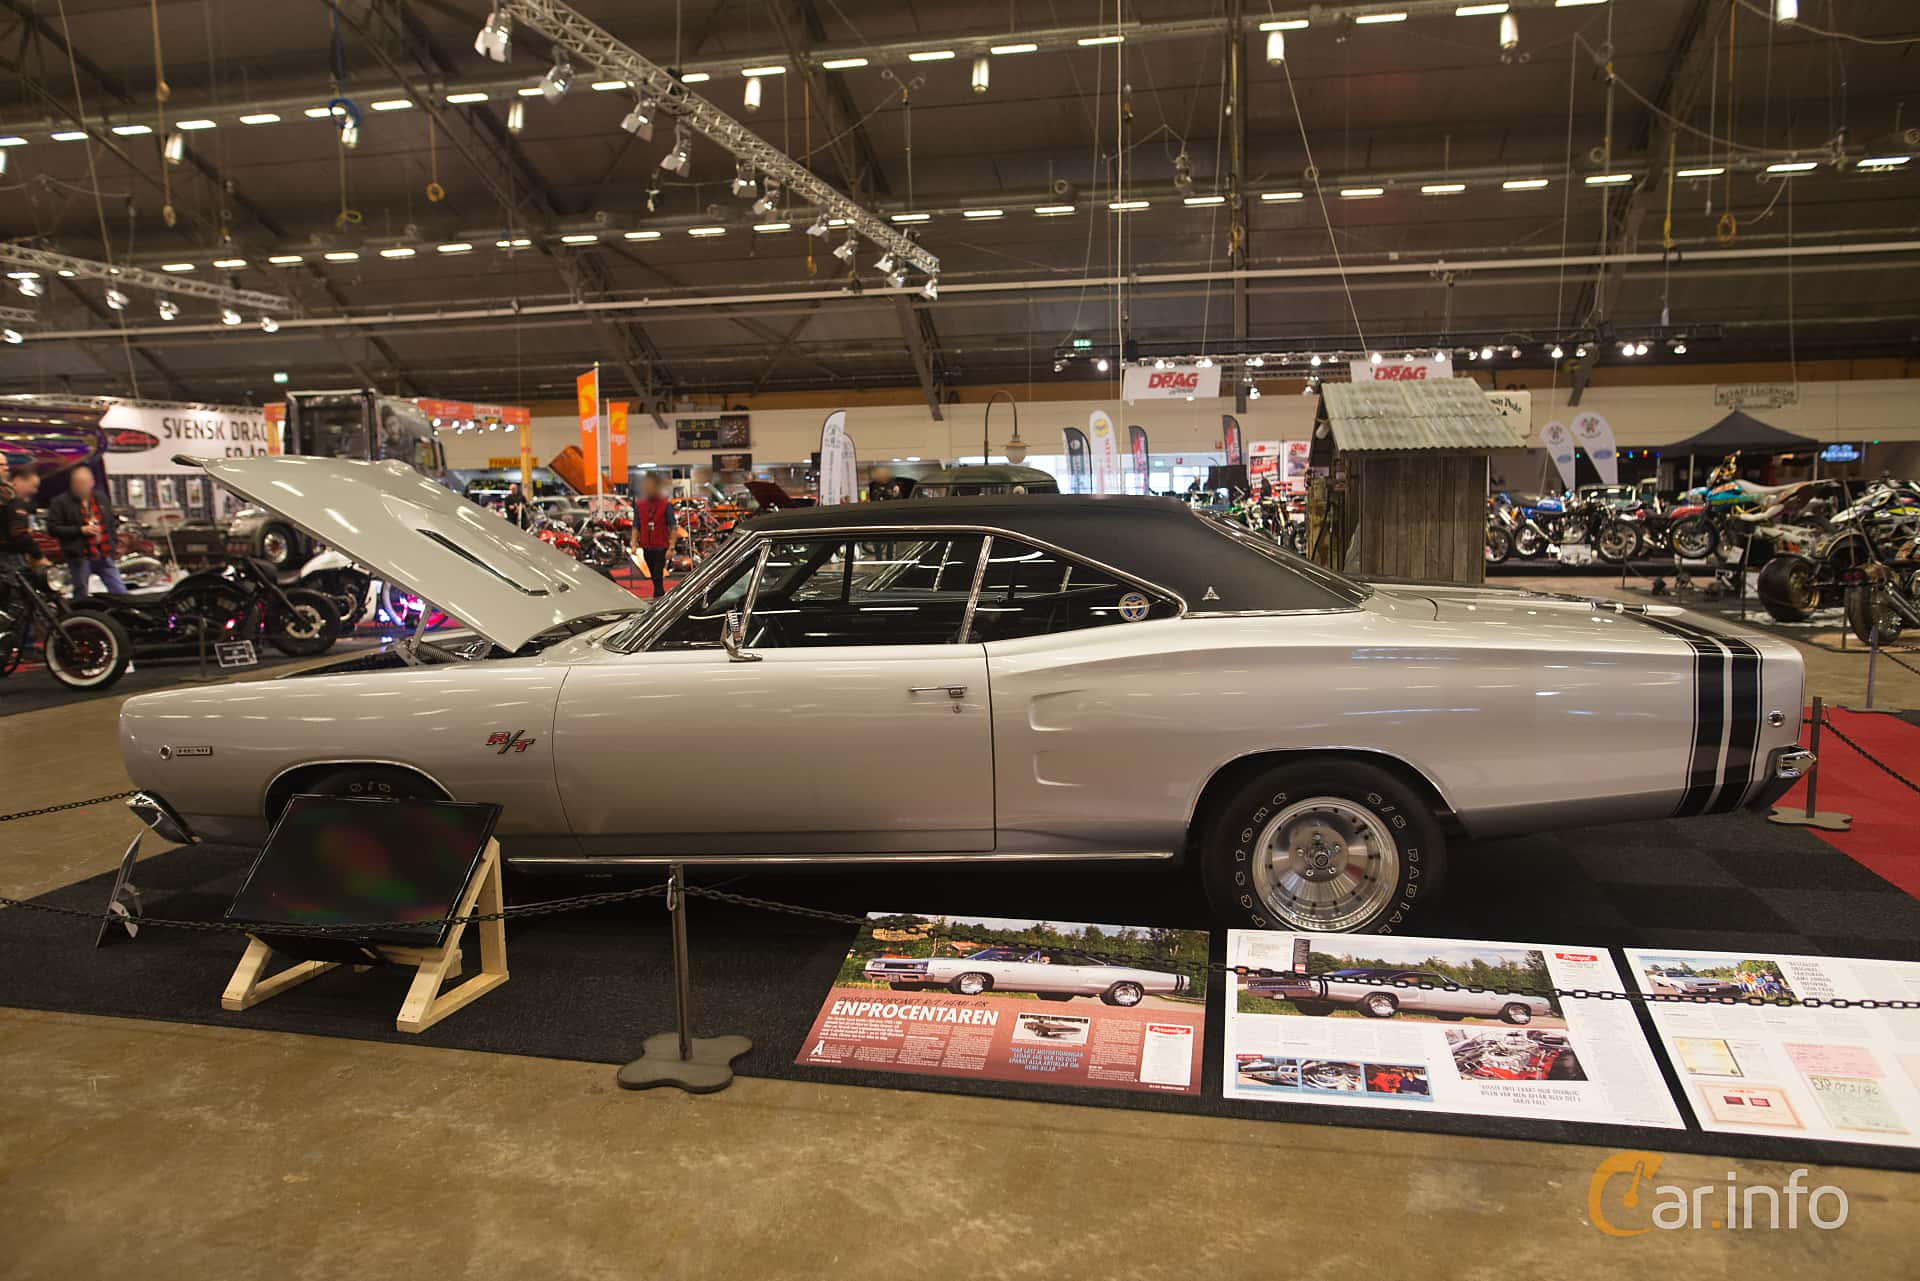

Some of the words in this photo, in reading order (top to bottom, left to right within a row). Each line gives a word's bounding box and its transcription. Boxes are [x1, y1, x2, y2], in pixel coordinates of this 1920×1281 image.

[1148, 372, 1199, 388] DRAG
[1374, 365, 1428, 381] DRAG
[162, 417, 225, 440] SVENSK
[485, 730, 536, 754] R/T
[1376, 848, 1420, 935] RADIAL
[831, 1000, 999, 1026] ENPROCENTAREN
